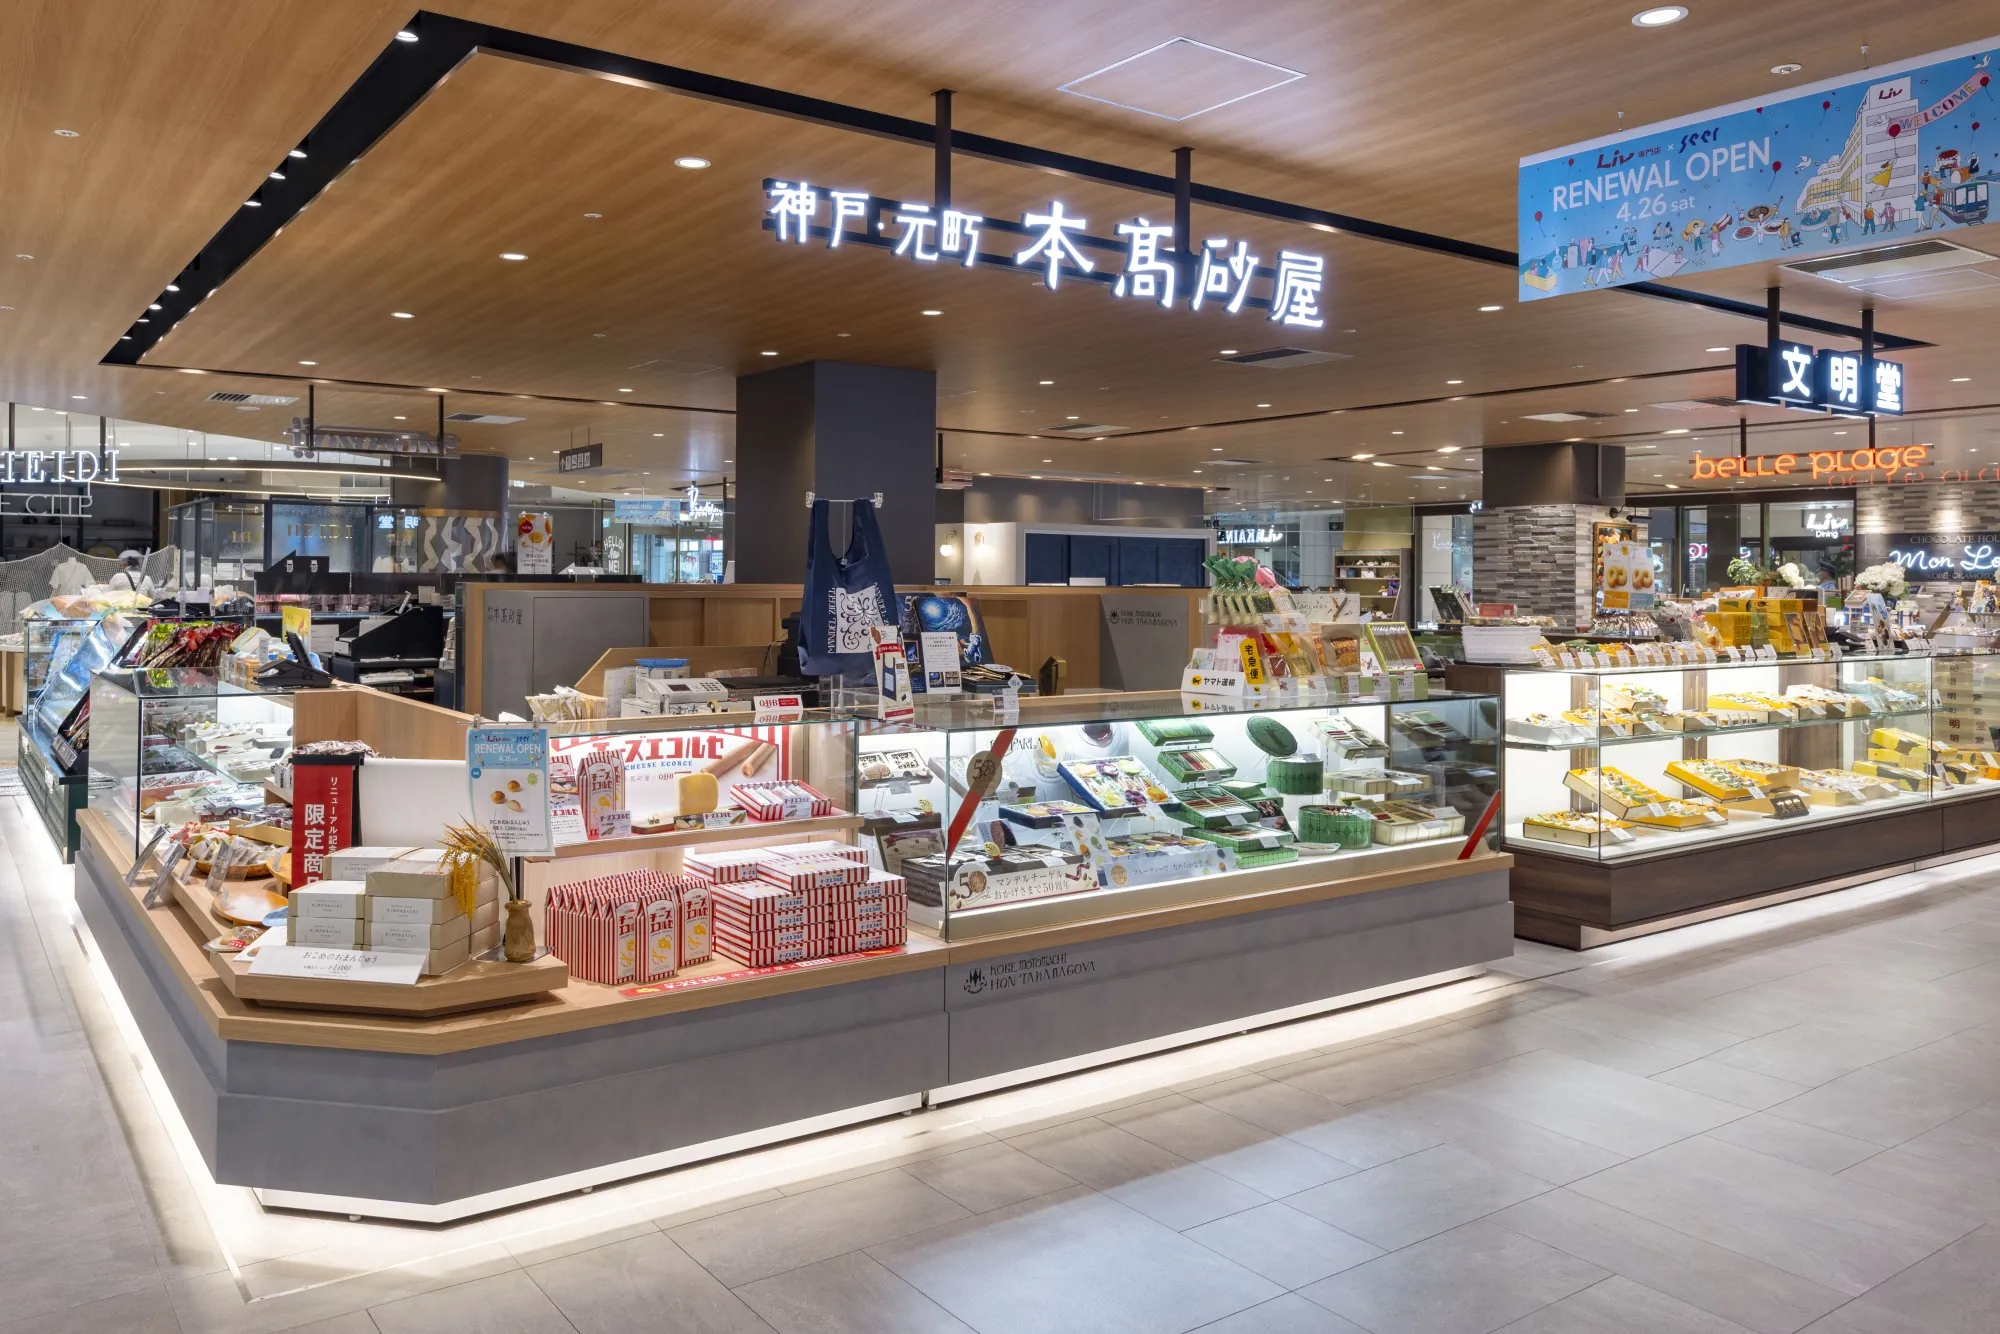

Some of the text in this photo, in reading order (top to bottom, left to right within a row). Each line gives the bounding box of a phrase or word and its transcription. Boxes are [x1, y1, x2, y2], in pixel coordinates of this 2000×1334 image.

[1878, 88, 1903, 100] Liv
[1900, 80, 1975, 130] WELCOME
[1597, 150, 1634, 169] Liv
[1553, 137, 1770, 212] RENEWAL OPEN
[1616, 193, 1696, 222] 4.26 sat
[1781, 346, 1901, 411] 文明堂
[1693, 453, 1797, 480] belle
[1808, 445, 1928, 480] plage
[1816, 530, 1838, 539] Dining
[1910, 535, 1974, 545] CHOCOLATE
[1889, 550, 1955, 570] Mon
[1245, 643, 1260, 681] 宅急便
[1203, 677, 1236, 688] ヤマト運輸
[475, 743, 541, 754] RENEWAL OPEN
[624, 761, 657, 771] CHEESE
